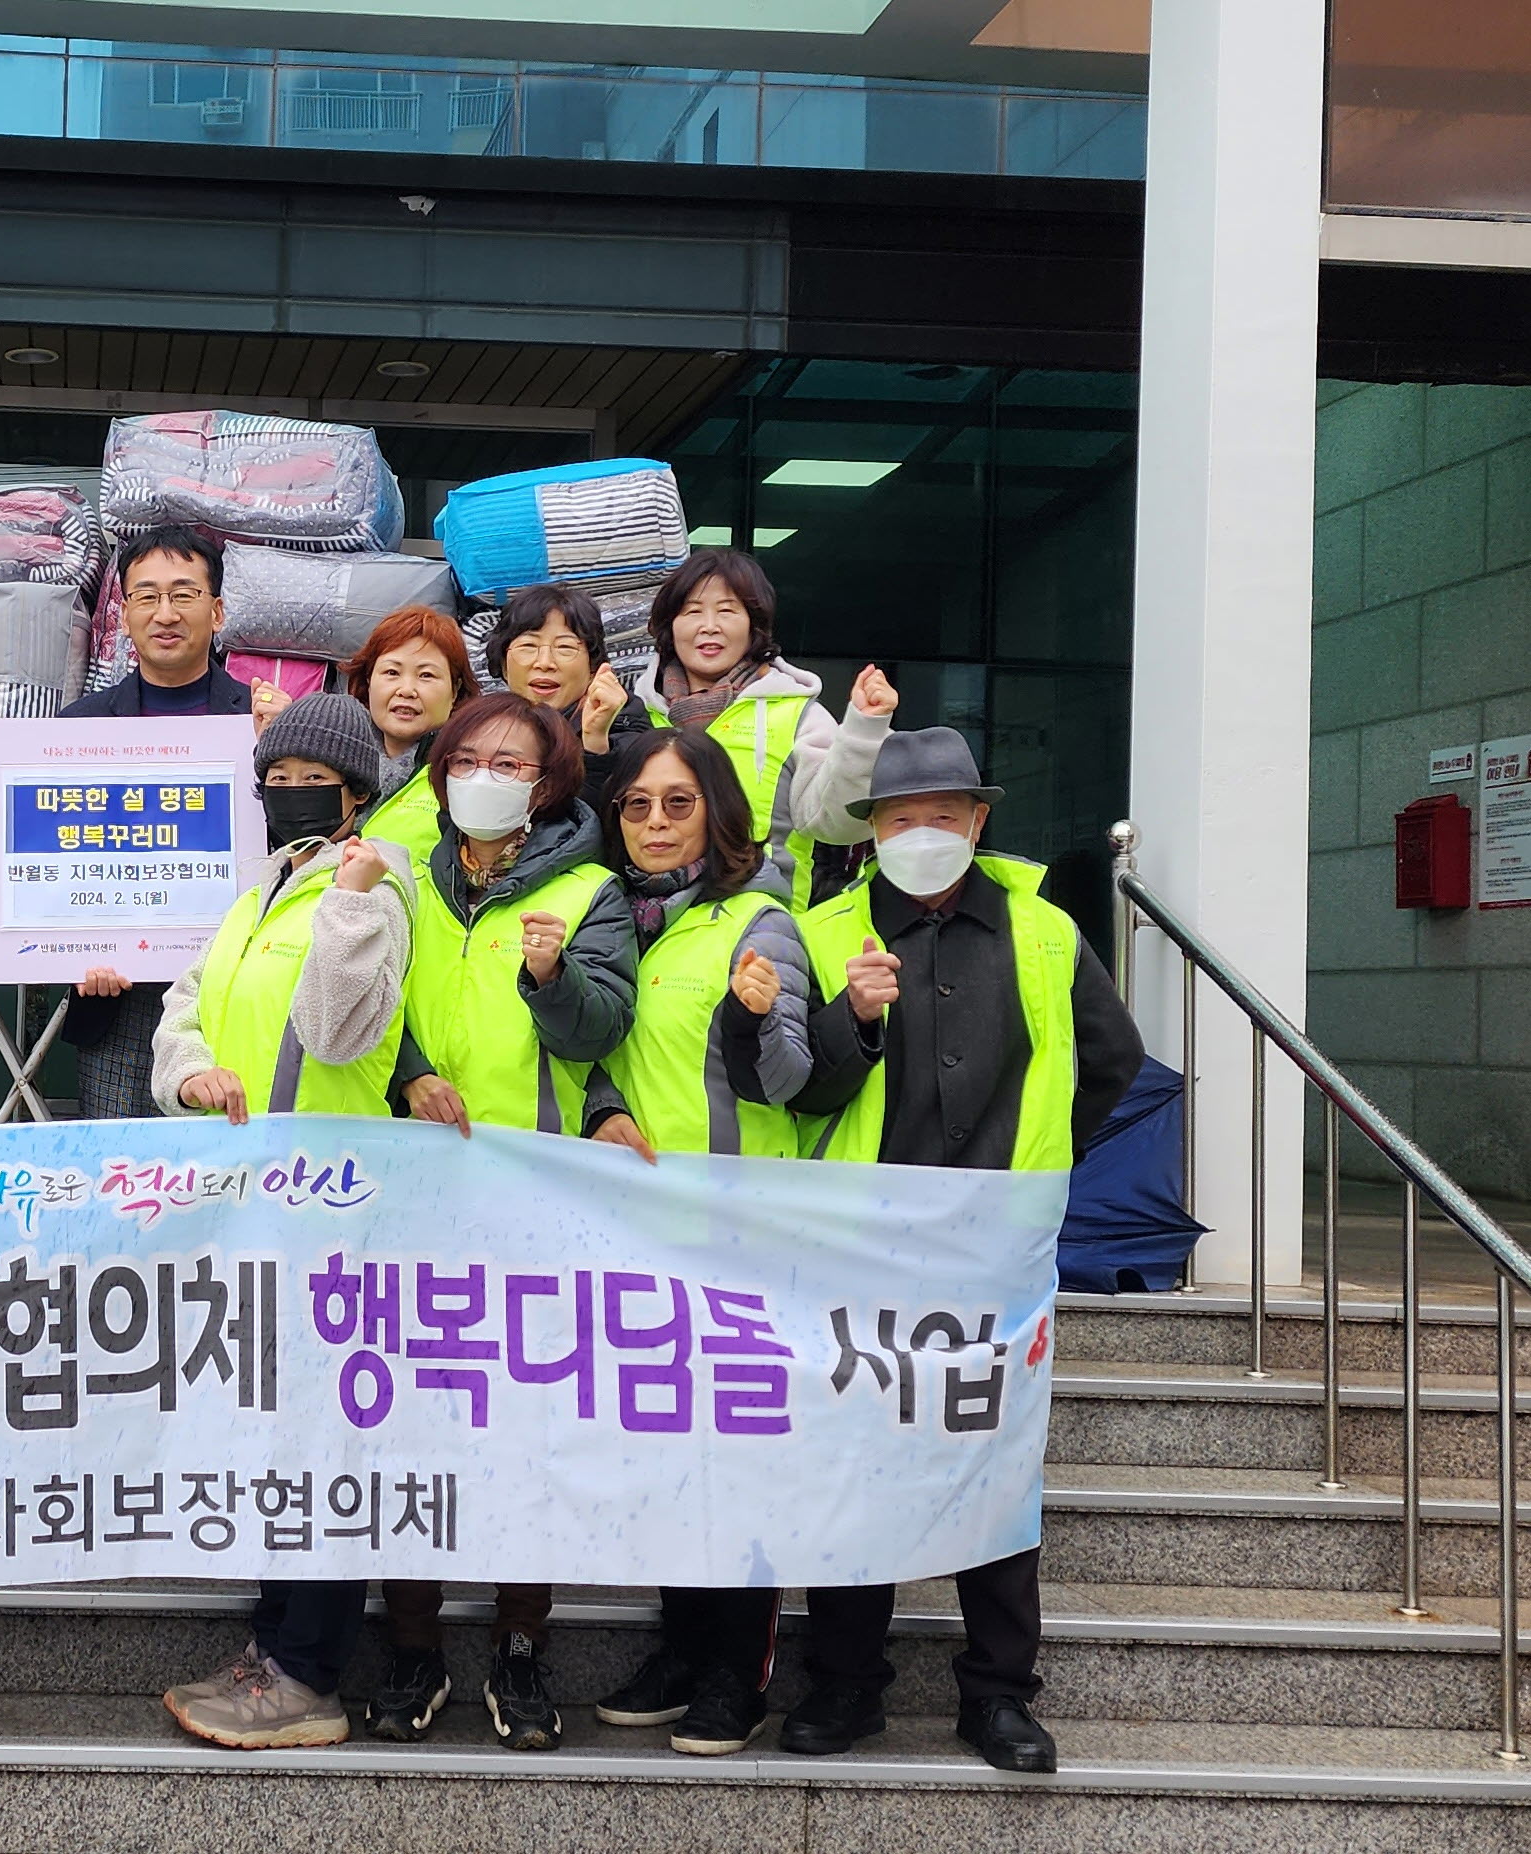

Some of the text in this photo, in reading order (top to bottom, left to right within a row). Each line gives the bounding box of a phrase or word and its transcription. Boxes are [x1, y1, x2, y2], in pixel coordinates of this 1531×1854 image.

[36, 787, 206, 812] 따뜻한 설 명절
[57, 824, 179, 849] 행복꾸러미
[8, 862, 229, 882] 반월동 지역사회보장협의체
[70, 892, 108, 906] 2024.
[114, 892, 127, 906] 2.
[105, 1161, 247, 1224] 혁신도시
[262, 1156, 377, 1208] 안산
[308, 1250, 798, 1436] 행복디딤돌
[829, 1305, 1008, 1434] 사업
